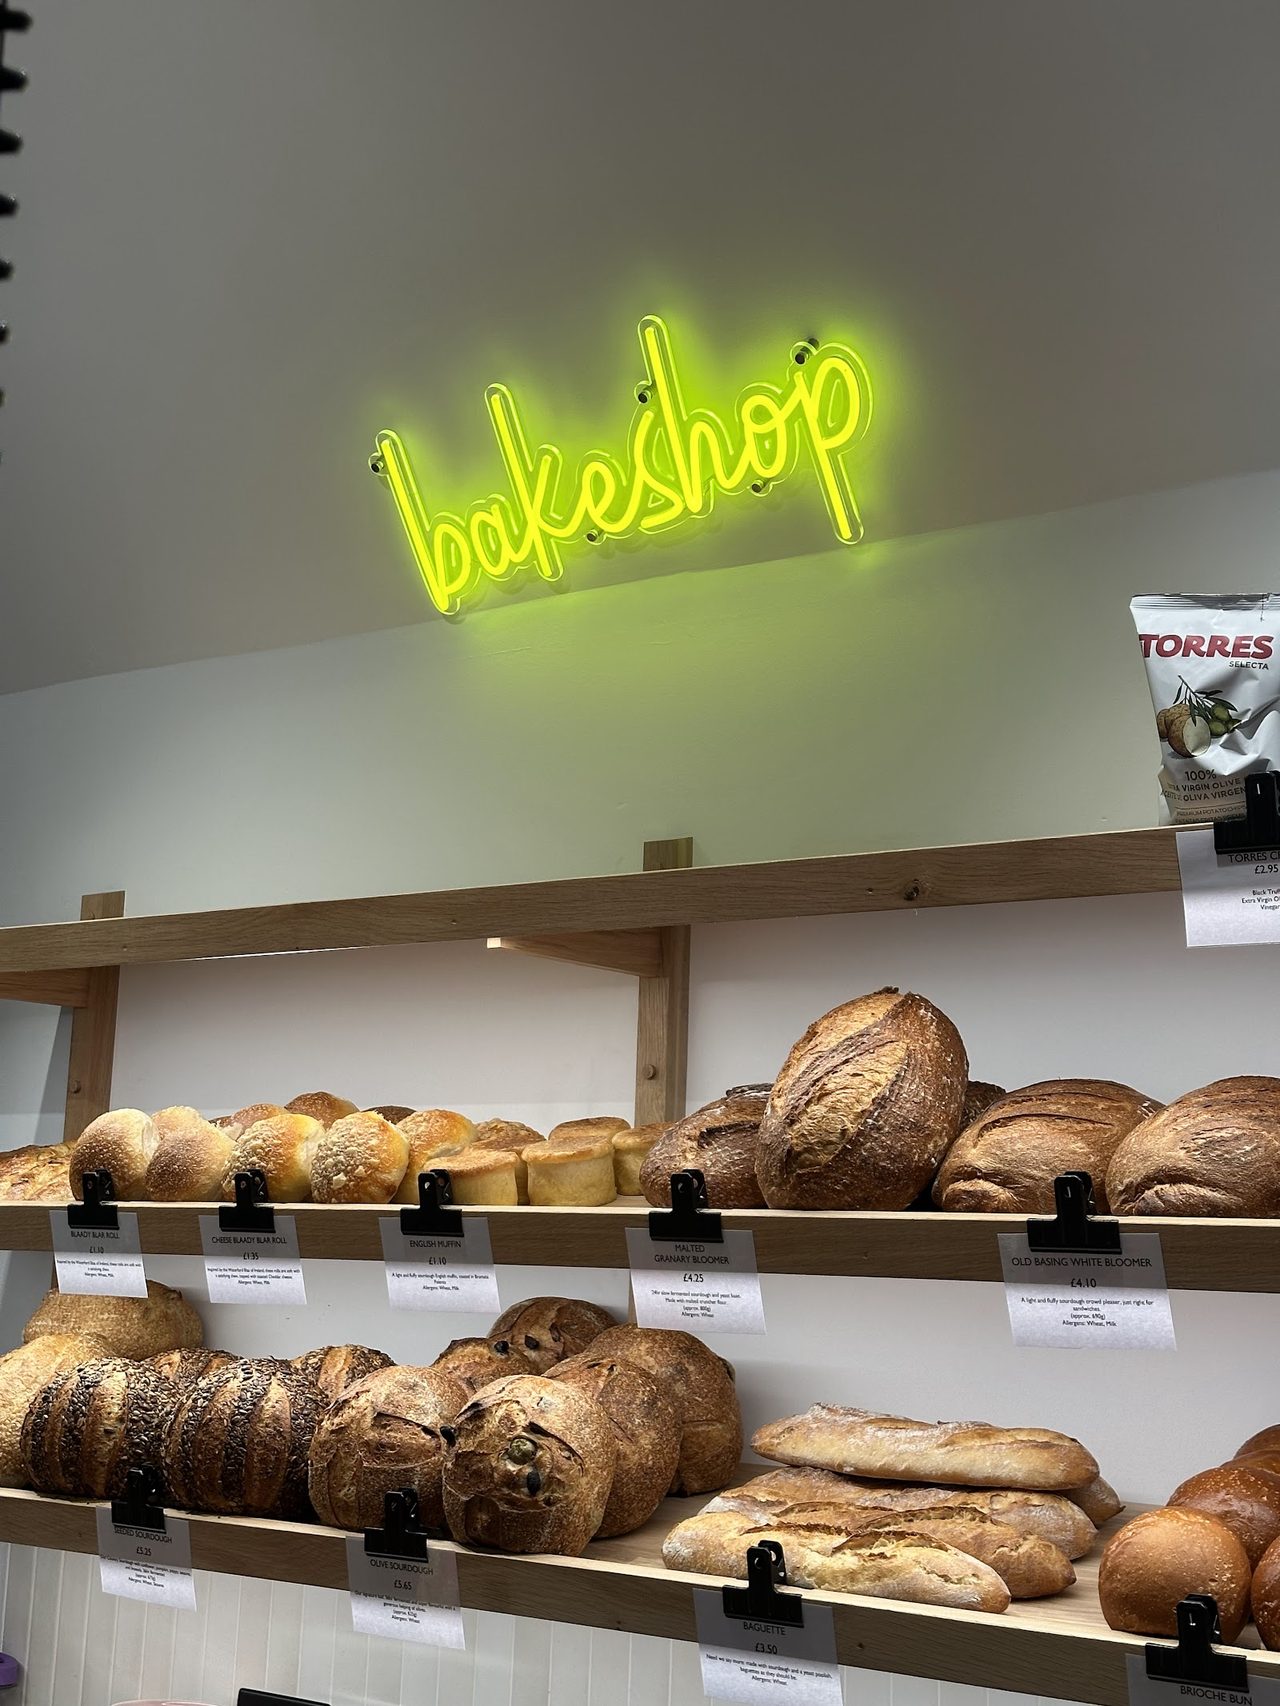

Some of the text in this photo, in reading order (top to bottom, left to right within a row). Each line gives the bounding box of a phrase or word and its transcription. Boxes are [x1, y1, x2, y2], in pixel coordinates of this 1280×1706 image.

[381, 325, 862, 612] bakeshop
[1139, 634, 1274, 659] TORRES
[1229, 661, 1269, 670] SELECTA
[1185, 769, 1217, 781] 100%
[1182, 783, 1210, 792] VIRGIN
[1212, 778, 1240, 789] OLIVE
[1184, 793, 1210, 801] OLIVA
[1229, 853, 1267, 863] TORRES
[1255, 864, 1279, 874] £2.95
[410, 1240, 436, 1248] ENGLISH
[675, 1245, 705, 1253] MALTED
[243, 1252, 259, 1260] £1.35
[429, 1257, 447, 1265] £1.10
[654, 1254, 730, 1265] GRANARY BLOOMER
[1012, 1257, 1152, 1267] OLD BASING WHITE BLOOMER
[683, 1273, 704, 1283] £4.25
[1071, 1278, 1097, 1288] £4.10
[135, 1531, 172, 1544] SOURDOUGH
[136, 1547, 152, 1556] £5.25
[370, 1559, 434, 1575] OLIVE SOURDOUGH
[394, 1580, 412, 1590] £5.65
[743, 1621, 787, 1636] BAGUETTE
[756, 1642, 778, 1655] £3.50
[1180, 1686, 1253, 1706] BRIOCHE BUN
